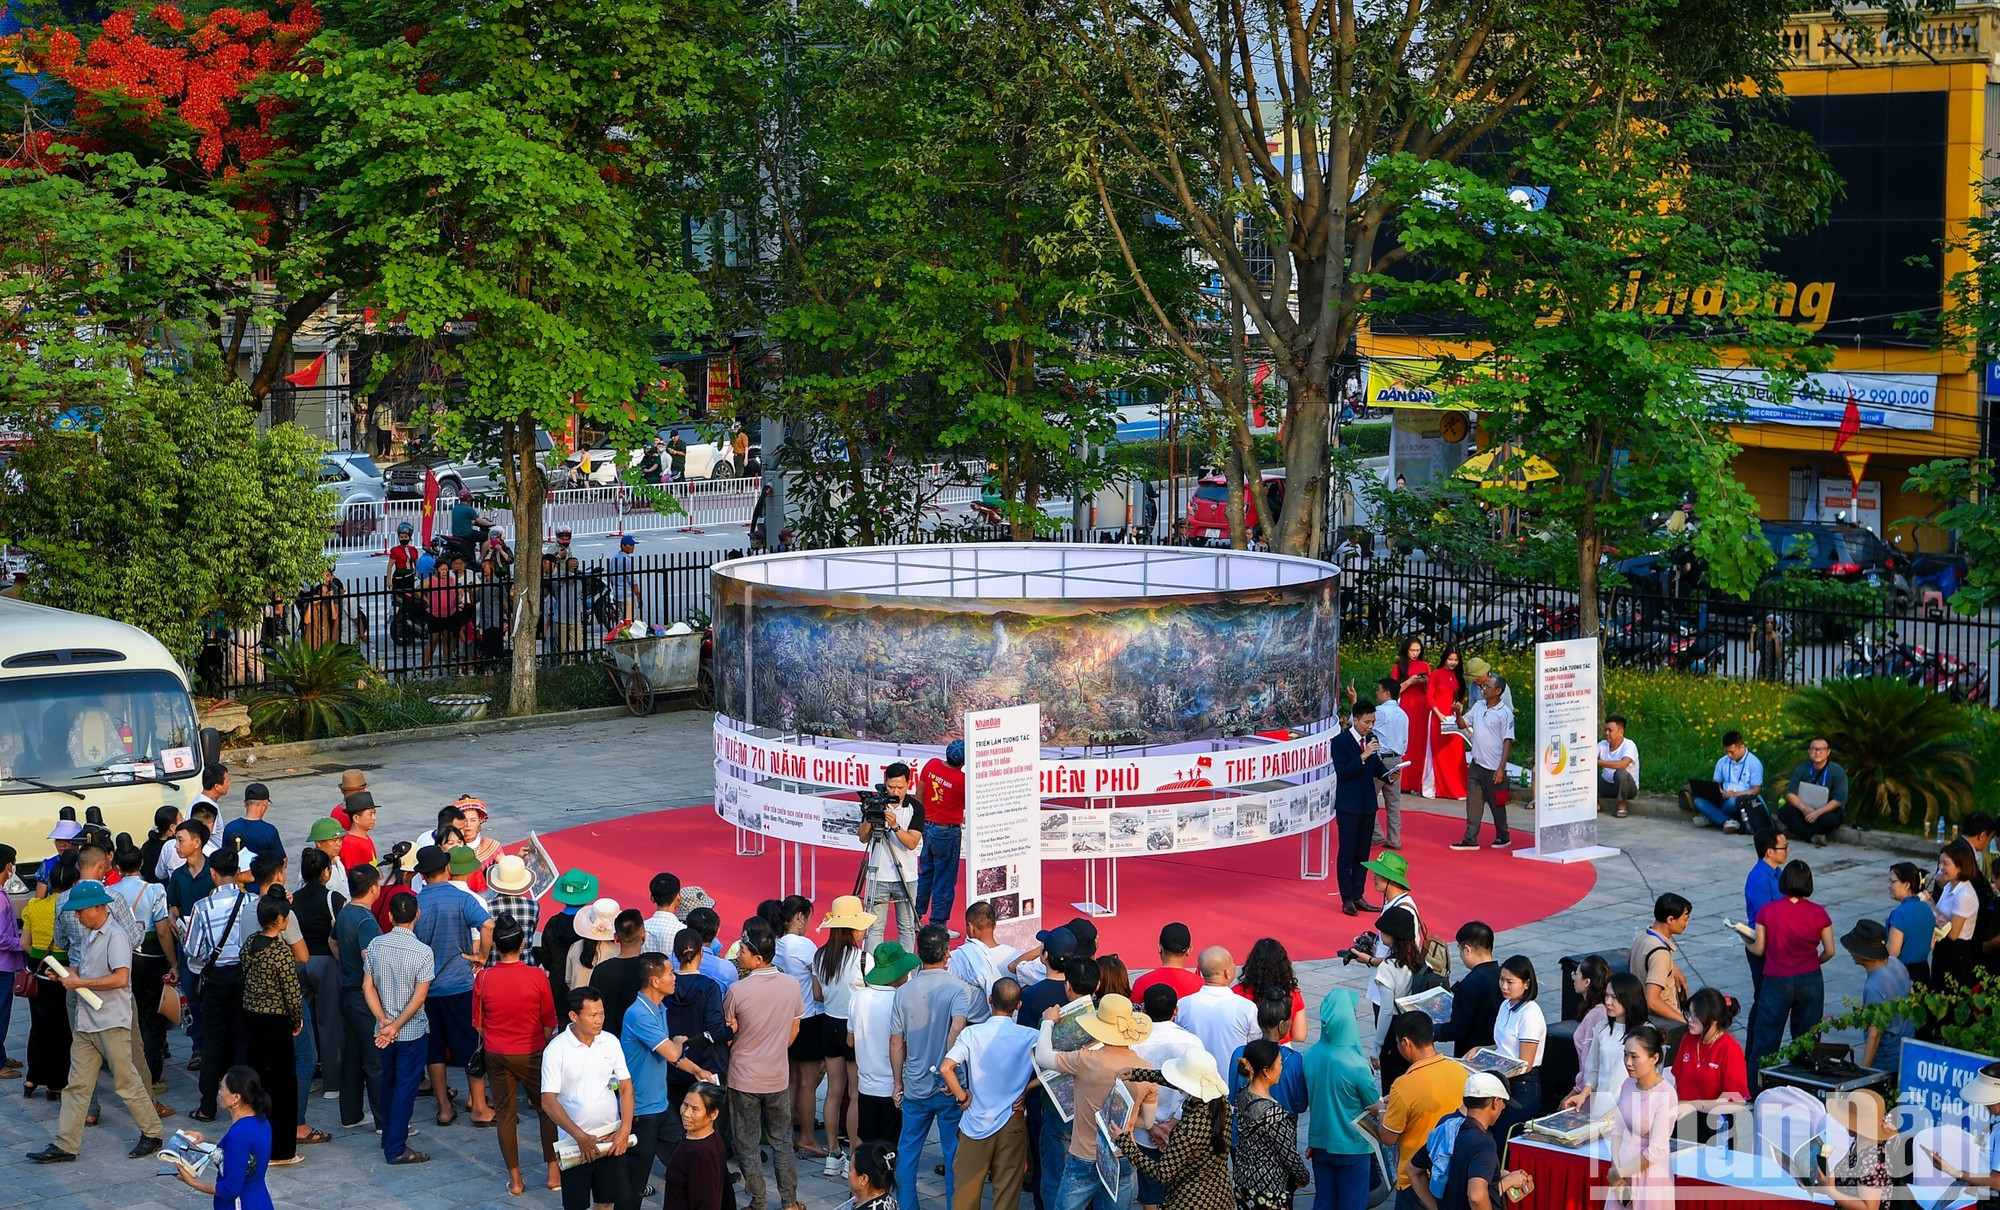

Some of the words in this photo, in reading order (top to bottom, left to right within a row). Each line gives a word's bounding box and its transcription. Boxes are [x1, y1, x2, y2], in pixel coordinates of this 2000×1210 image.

[976, 718, 989, 728] Nhân
[990, 717, 1000, 726] Dân
[174, 757, 184, 769] B
[725, 736, 747, 767] NIỆM
[751, 748, 766, 771] 70
[770, 749, 808, 780] NĂM
[813, 755, 870, 787] CHIẾN
[1096, 763, 1139, 793] PHỦ
[1225, 757, 1257, 783] THE
[1262, 740, 1328, 779] PANORAMA
[1917, 1060, 1948, 1084] QUÝ
[1908, 1086, 1929, 1111] TỰ
[1931, 1089, 1962, 1116] BẢO
